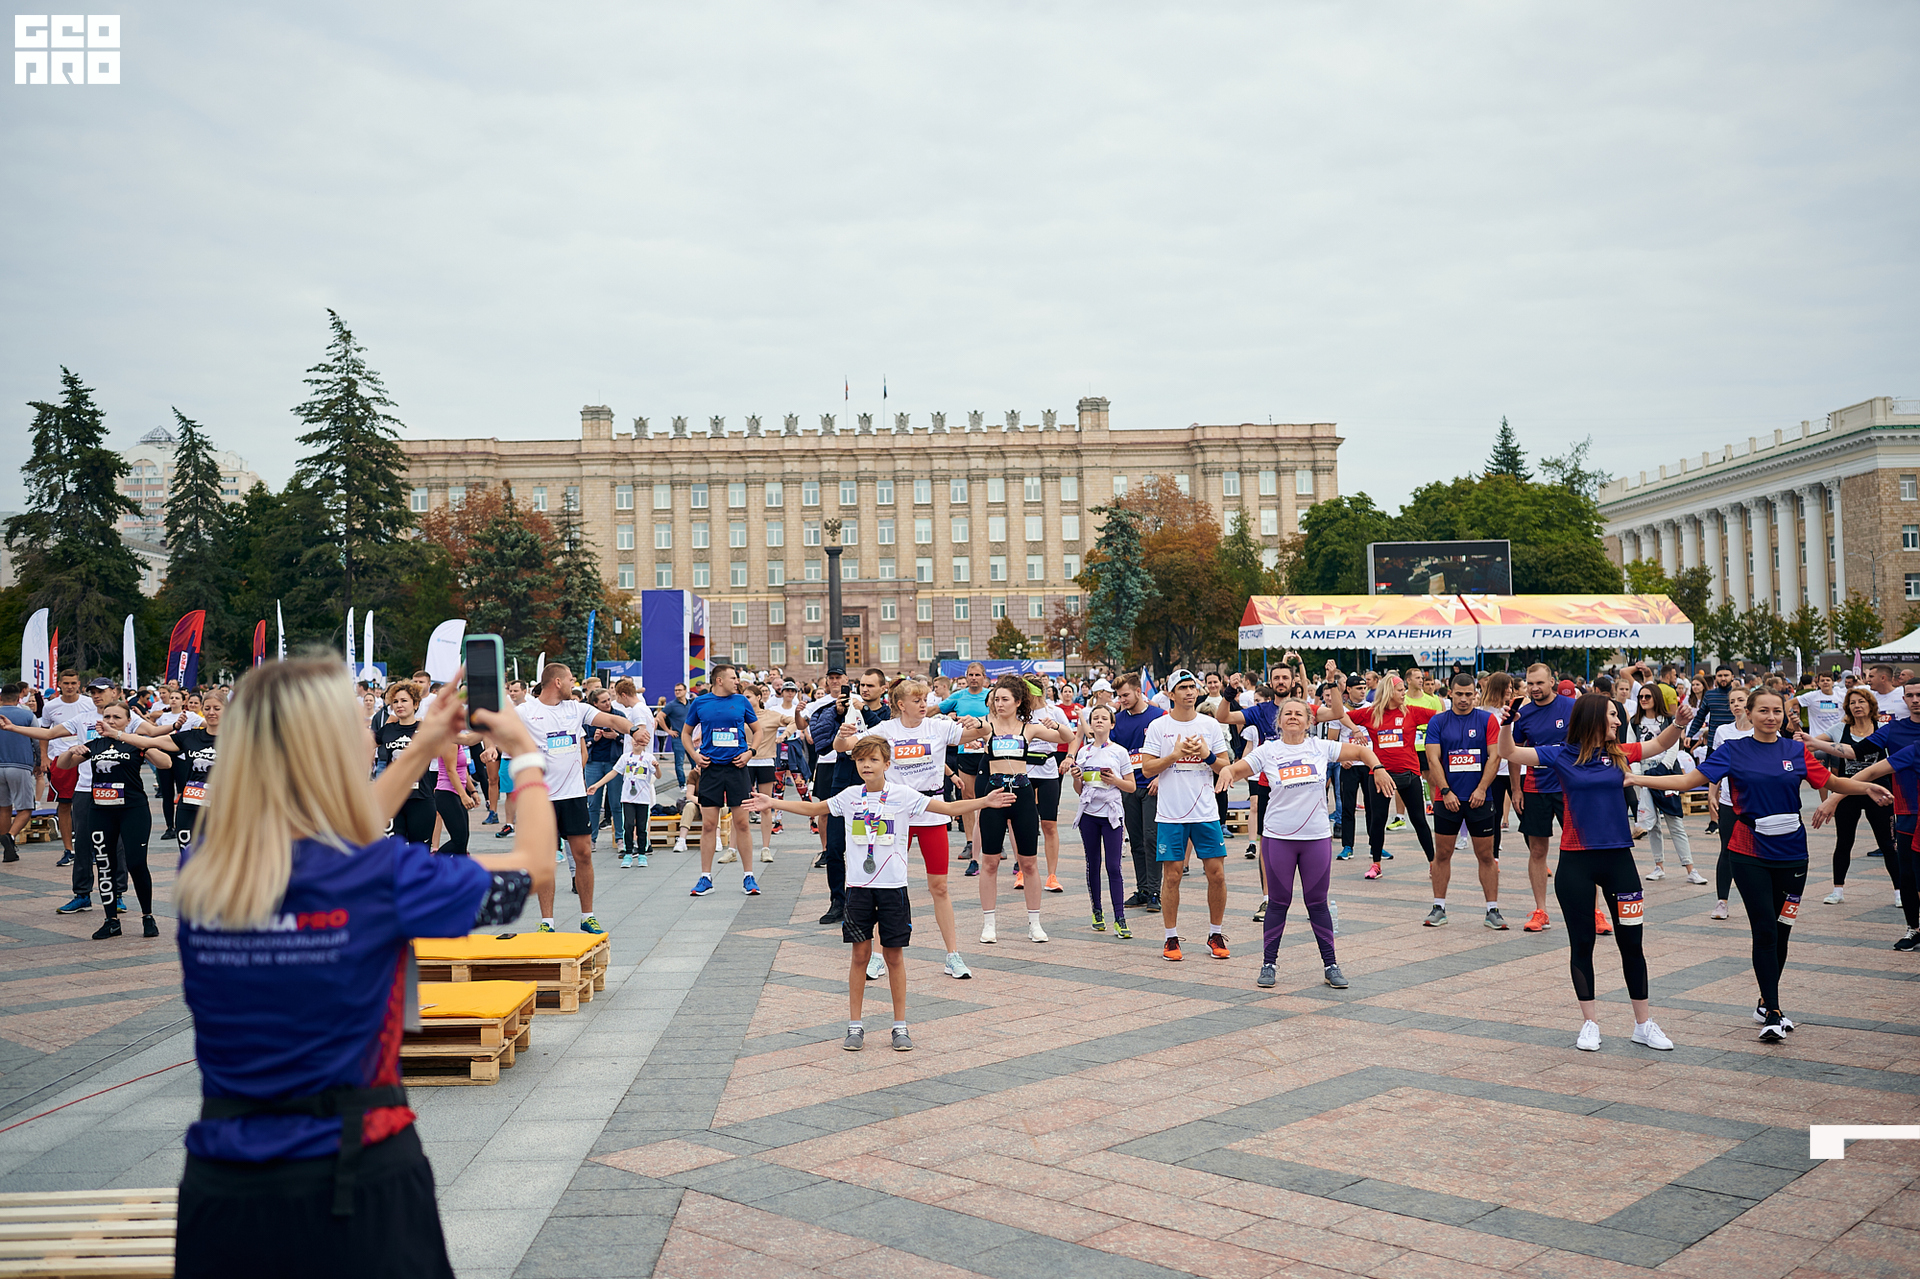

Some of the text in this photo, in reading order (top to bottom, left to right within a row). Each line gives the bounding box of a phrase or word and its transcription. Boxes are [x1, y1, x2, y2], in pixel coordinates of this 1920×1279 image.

[1290, 629, 1452, 640] КАМЕРА ХРАНЕНИЯ
[1532, 628, 1640, 638] ГРАВИРОВКА
[716, 732, 731, 740] 1331
[1379, 734, 1397, 742] 5441
[551, 737, 570, 747] 1018
[996, 740, 1015, 749] 1257
[897, 746, 922, 756] 5241
[1451, 755, 1474, 765] 2034
[1282, 766, 1309, 778] 5133
[95, 789, 117, 798] 5562
[184, 787, 205, 797] 5563
